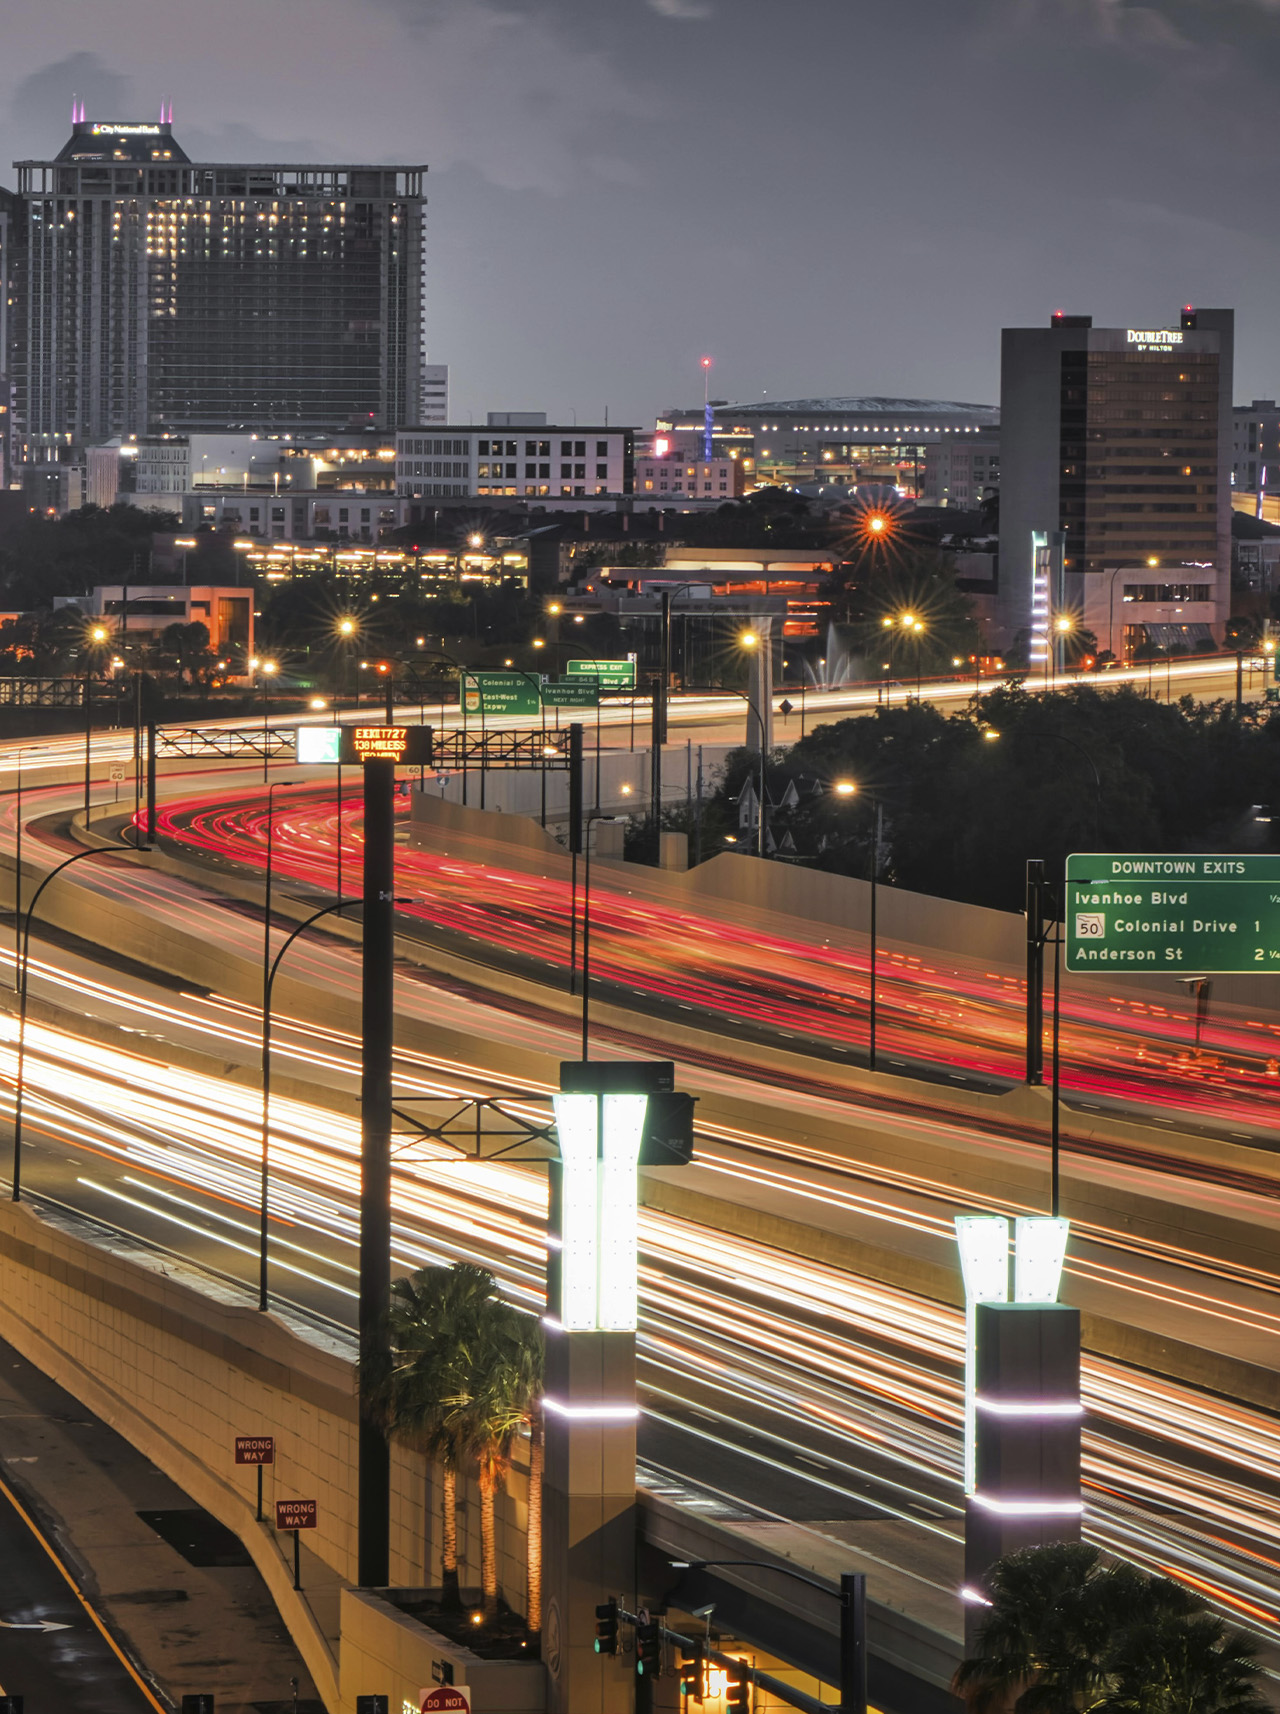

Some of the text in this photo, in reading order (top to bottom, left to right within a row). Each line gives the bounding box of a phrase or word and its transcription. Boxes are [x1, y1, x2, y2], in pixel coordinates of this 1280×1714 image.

[100, 125, 160, 134] City National Bank
[482, 693, 518, 701] East-West
[483, 703, 507, 712] Expwy
[111, 772, 123, 780] 60
[1112, 861, 1246, 874] DOWNTOWN EXITS
[1075, 891, 1143, 905] Ivanhoe
[1151, 891, 1188, 905] Blvd
[1080, 919, 1260, 935] 50 Colonial Drive 1
[1075, 947, 1156, 960] Anderson
[1165, 947, 1183, 960] St
[1254, 948, 1265, 961] 2
[237, 1440, 272, 1450] WRONG
[243, 1451, 266, 1460] WAY
[278, 1503, 315, 1513] WRONG
[285, 1515, 308, 1525] WAY
[427, 1697, 463, 1708] DO NOT
